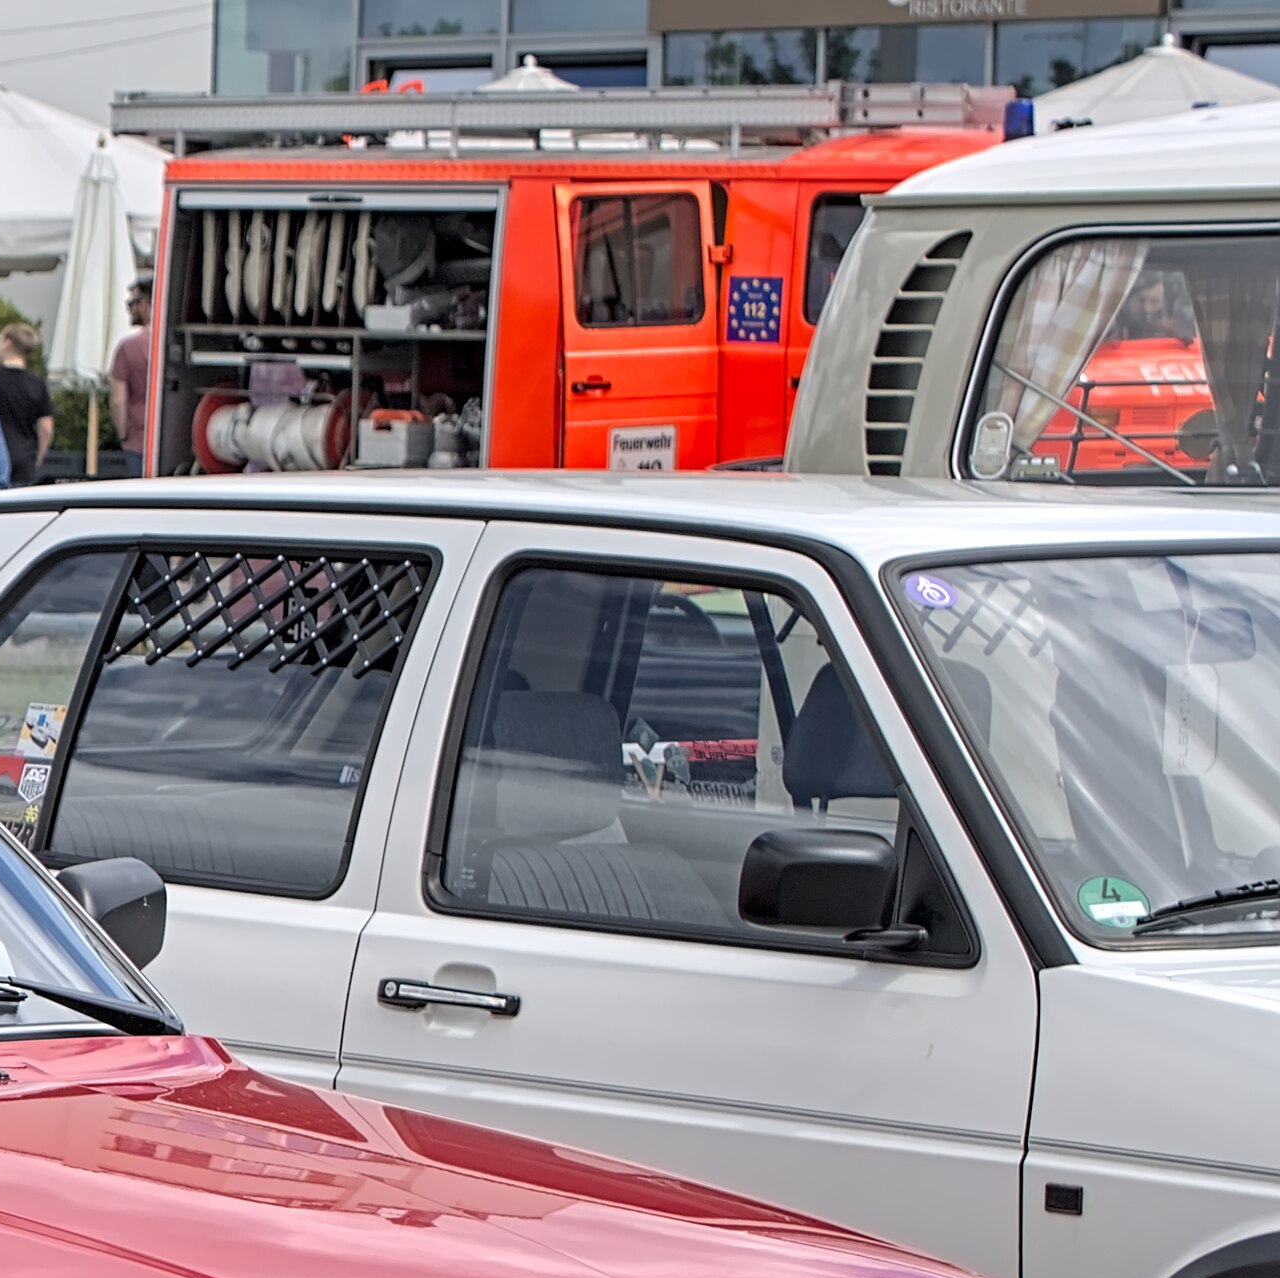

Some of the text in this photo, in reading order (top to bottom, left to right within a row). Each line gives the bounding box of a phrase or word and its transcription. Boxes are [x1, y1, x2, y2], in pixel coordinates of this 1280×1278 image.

[908, 0, 1028, 18] RISTORANTE
[743, 301, 767, 319] 112
[613, 430, 672, 452] Feuerwehr
[1101, 878, 1122, 902] 4
